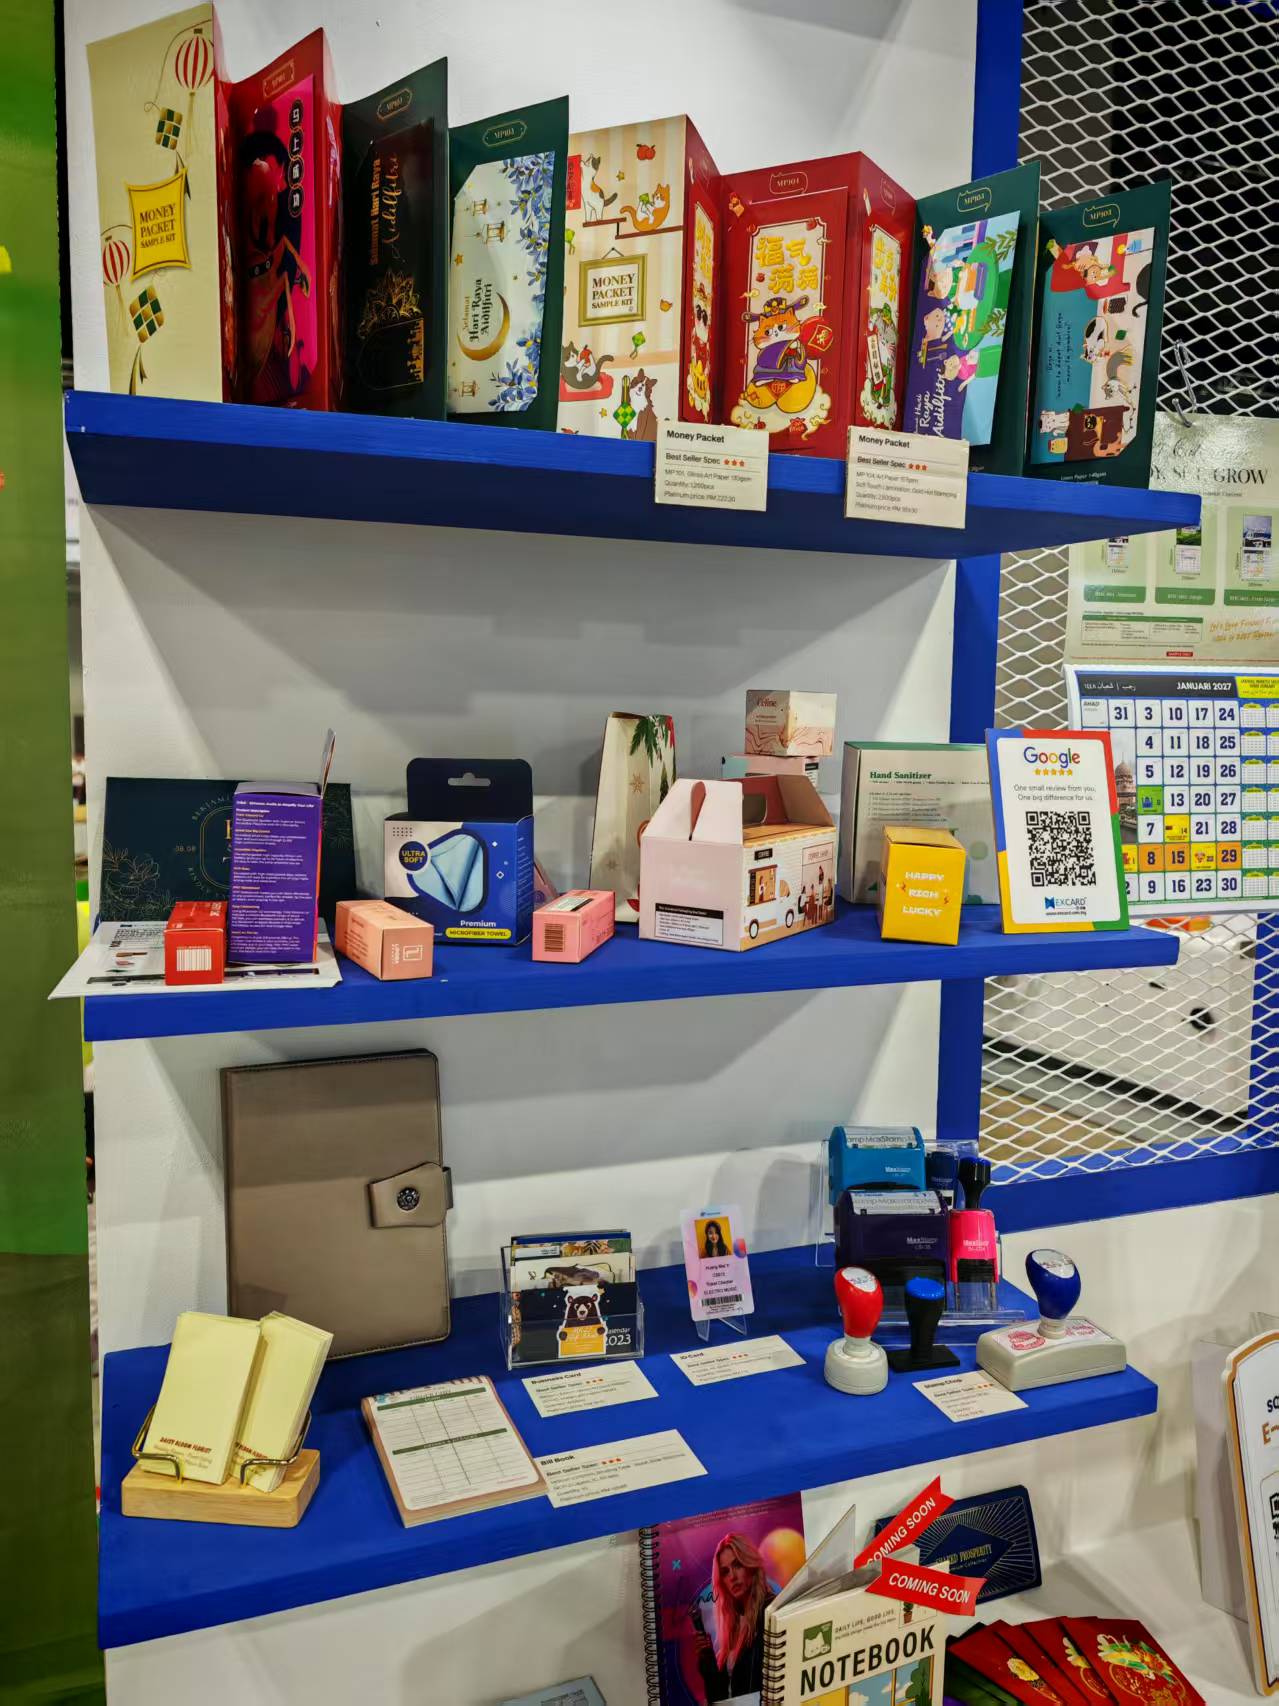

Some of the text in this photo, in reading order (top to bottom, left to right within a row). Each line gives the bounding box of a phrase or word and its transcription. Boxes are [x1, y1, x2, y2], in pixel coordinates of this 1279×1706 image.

[371, 158, 381, 190] Raya
[370, 190, 380, 217] Hari
[140, 203, 175, 223] MONEY
[140, 219, 174, 239] PACKET
[756, 236, 811, 267] 福气
[592, 273, 635, 289] MONEY
[768, 264, 819, 295] 满满
[592, 286, 634, 300] PACKET
[469, 278, 483, 343] Hari Raya
[480, 283, 493, 337] Aidilfitri
[591, 298, 633, 309] SAMPLE KIT
[919, 390, 934, 428] Raya
[666, 430, 725, 443] Money Packet
[859, 435, 910, 449] Money Packet
[666, 452, 682, 461] Best
[683, 454, 703, 463] Seller
[857, 456, 872, 464] Best
[872, 457, 890, 466] Seller
[1213, 468, 1268, 485] GROW
[1176, 682, 1232, 691] JANUARI 2027
[1114, 706, 1235, 721] 31 3 10 17 24
[1145, 735, 1236, 749] 4 11 18 25
[1023, 746, 1081, 769] Google
[870, 771, 932, 779] Hand Sanitizer
[1145, 764, 1236, 778] 5 12 19 26
[1014, 784, 1028, 792] One
[1170, 793, 1184, 807] 13
[1194, 793, 1211, 806] 20
[1220, 792, 1237, 806] 27
[1146, 821, 1237, 836] 7 14 21 28
[1147, 851, 1155, 865] 8
[1171, 851, 1185, 865] 15
[1221, 850, 1237, 863] 29
[905, 871, 944, 881] HAPPY
[1147, 880, 1156, 894] 9
[1171, 879, 1186, 893] 16
[1195, 878, 1212, 892] 23
[1221, 877, 1238, 891] 30
[902, 905, 943, 917] LUCKY
[449, 929, 486, 937] MICROFIBER
[606, 1327, 632, 1335] alendar
[531, 1376, 564, 1385] Business
[160, 1436, 212, 1454] DAISY BLOOM FLORIST
[540, 1454, 576, 1466] Bill Book
[546, 1466, 581, 1477] Best Seller
[906, 1497, 936, 1529] SOON
[960, 1543, 992, 1562] PROSPERITY
[888, 1573, 971, 1604] COMING SOON
[834, 1624, 851, 1633] DAILY
[866, 1612, 881, 1622] GOOD
[800, 1624, 936, 1696] NOTEBOOK
